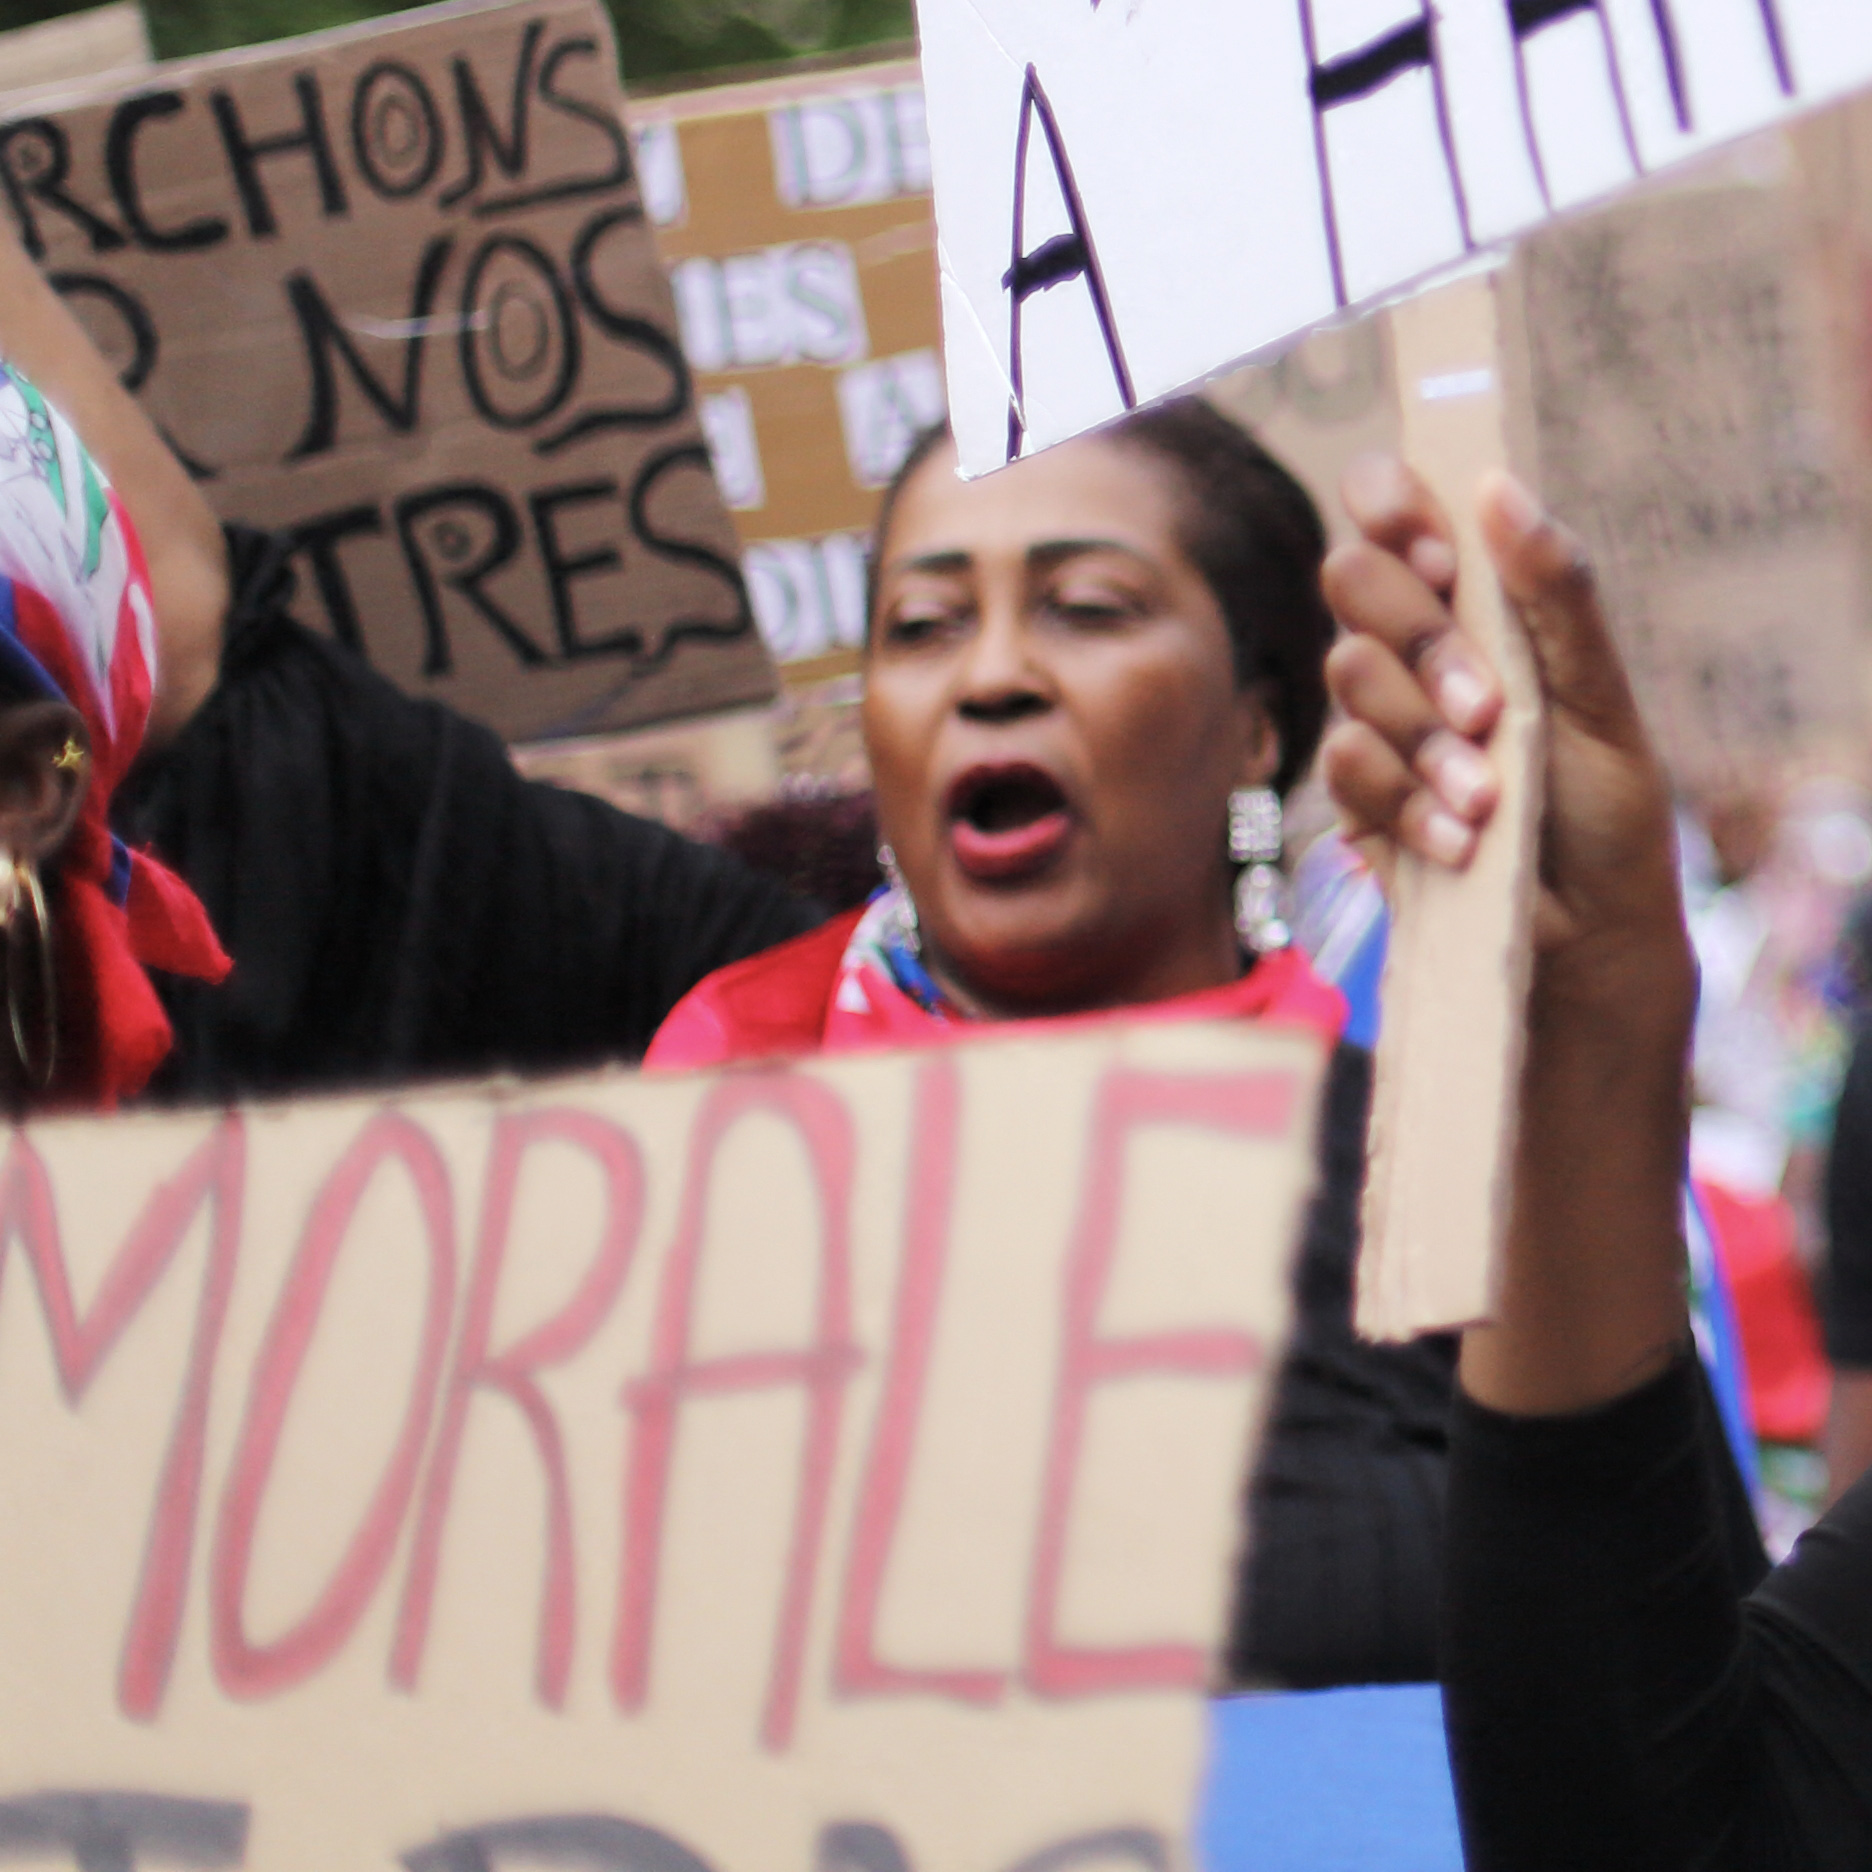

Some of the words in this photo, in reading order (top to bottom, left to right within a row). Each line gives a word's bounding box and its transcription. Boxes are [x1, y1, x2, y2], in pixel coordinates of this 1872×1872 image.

[284, 202, 693, 465] NOS
[1001, 61, 1138, 464] A
[0, 1052, 1300, 1756] MORALE
